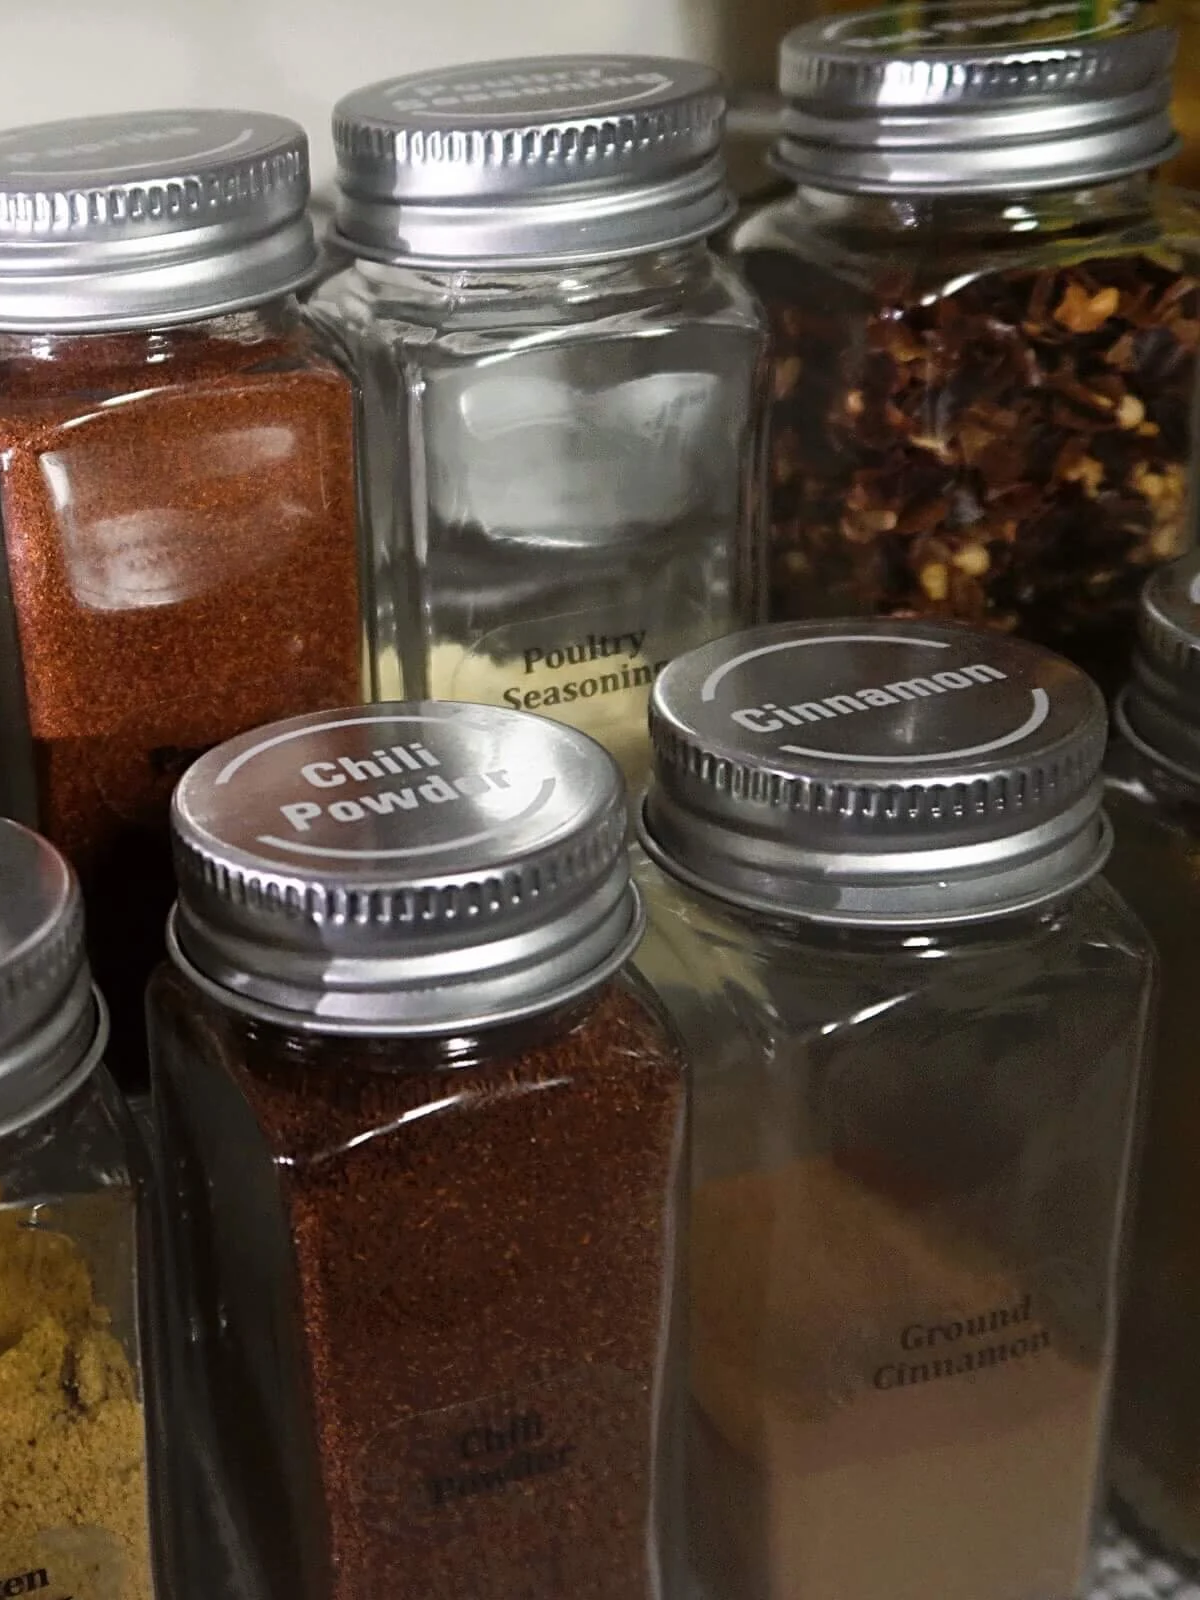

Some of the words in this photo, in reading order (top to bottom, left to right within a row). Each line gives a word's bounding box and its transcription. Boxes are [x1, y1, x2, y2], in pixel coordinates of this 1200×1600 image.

[523, 630, 647, 675] Poultry
[730, 663, 1008, 733] Cinnamon
[300, 742, 441, 788] Chili
[279, 768, 511, 832] Powder
[900, 1293, 1032, 1351] Ground
[873, 1331, 1050, 1390] Cinnamon
